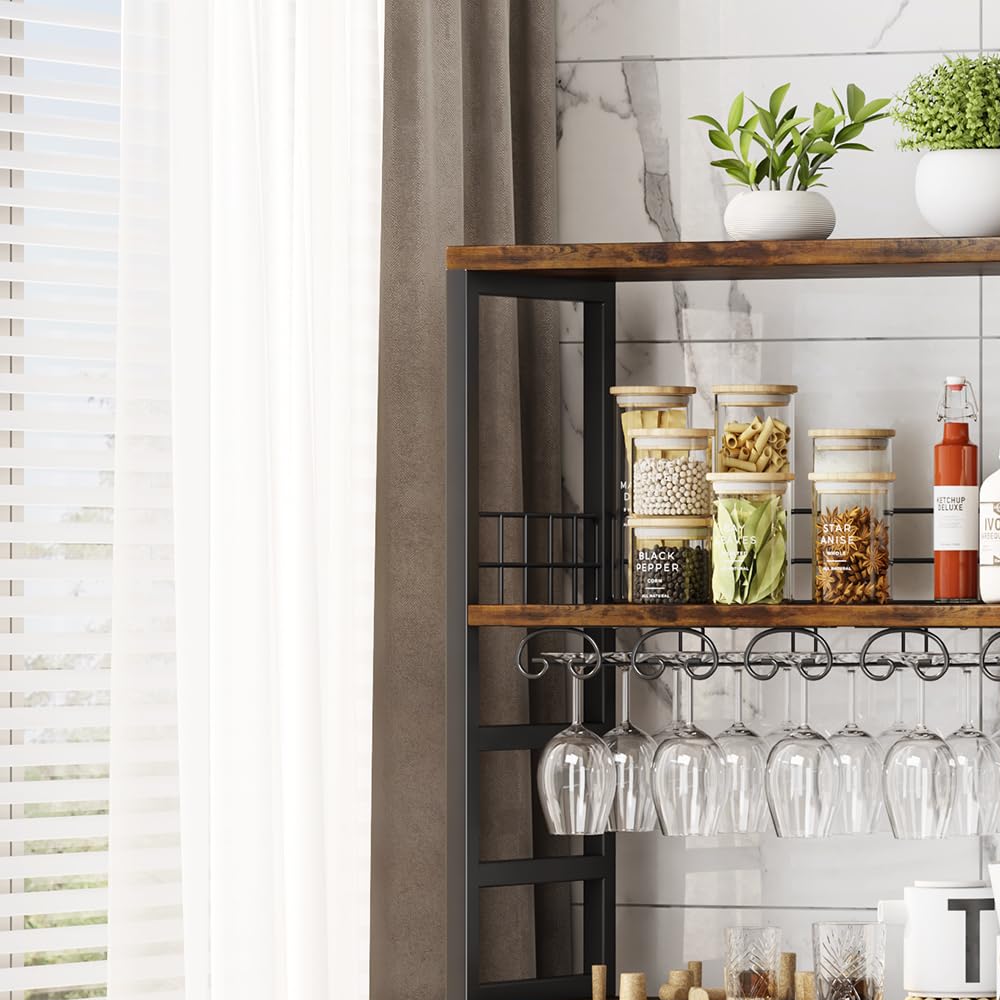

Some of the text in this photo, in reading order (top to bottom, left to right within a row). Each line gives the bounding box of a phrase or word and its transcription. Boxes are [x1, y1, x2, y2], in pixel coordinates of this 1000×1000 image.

[823, 523, 851, 533] STAR
[820, 535, 854, 545] ANISE
[638, 551, 675, 561] BLACK
[636, 563, 679, 573] PEPPER
[947, 898, 995, 984] T
